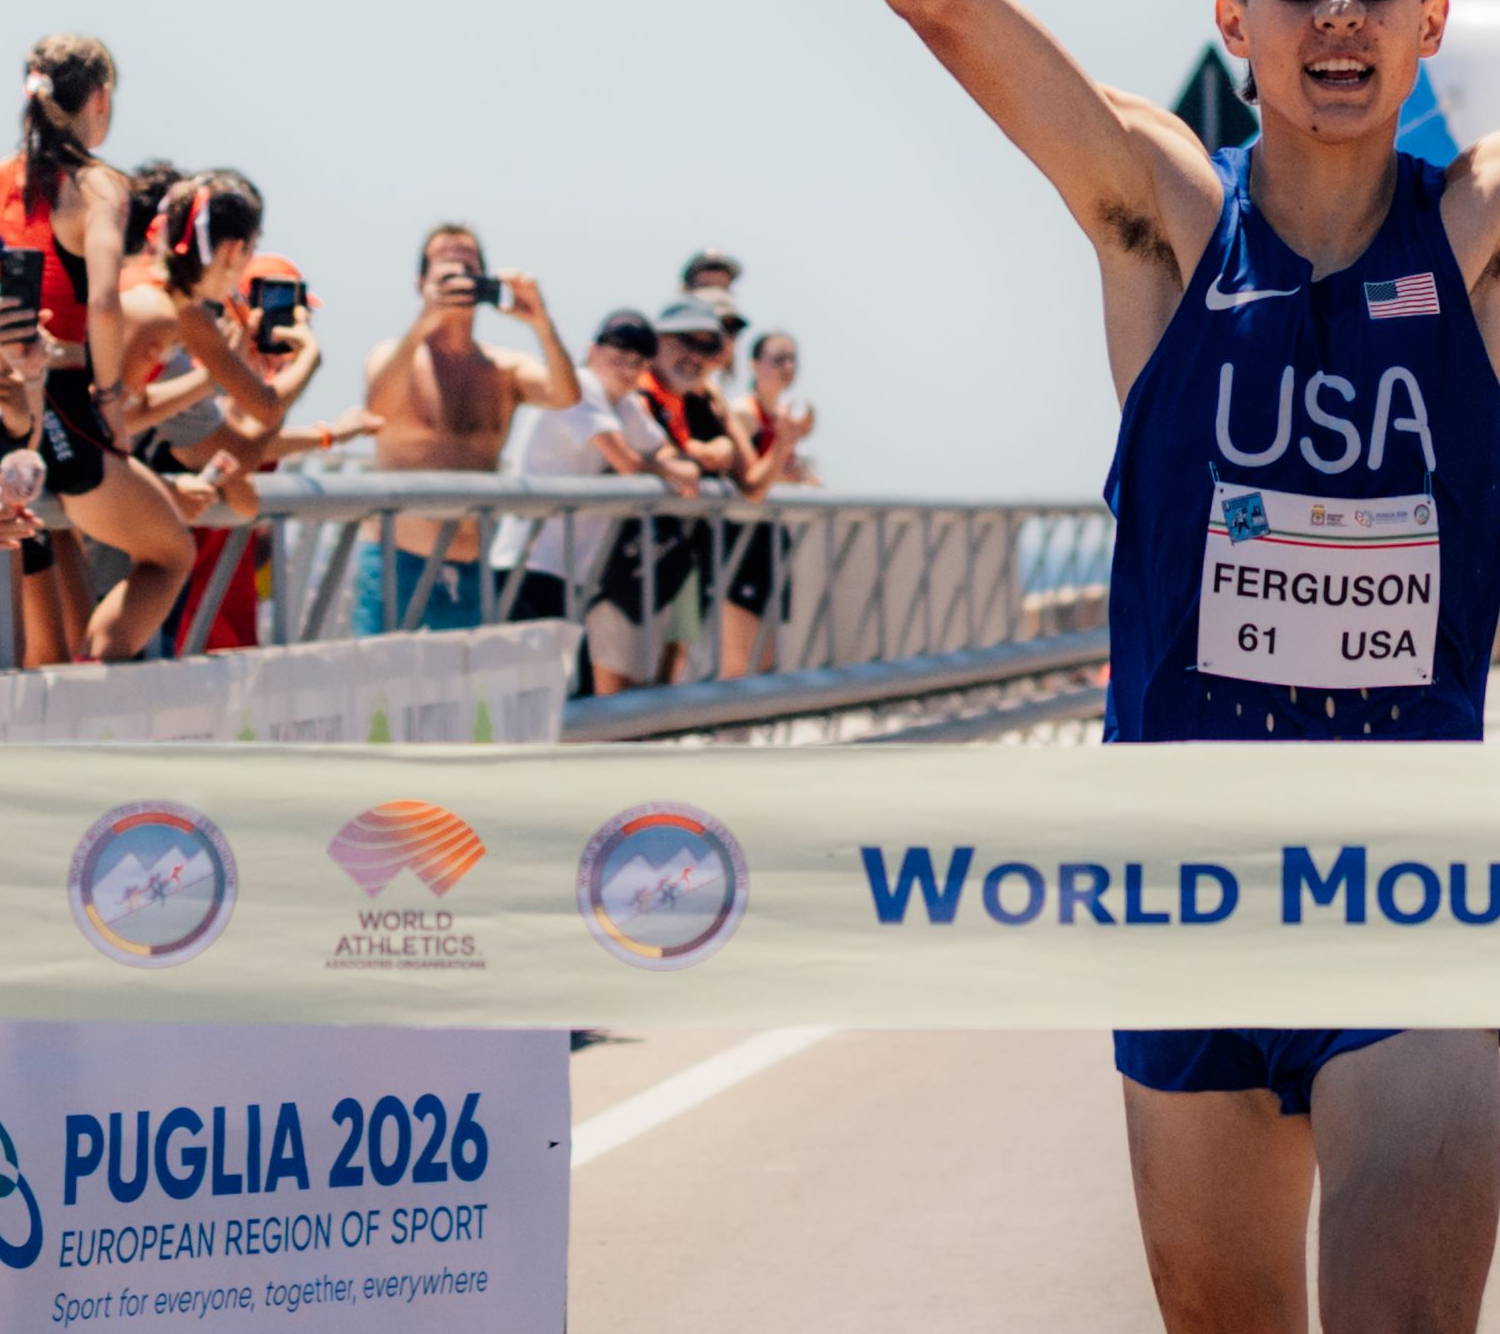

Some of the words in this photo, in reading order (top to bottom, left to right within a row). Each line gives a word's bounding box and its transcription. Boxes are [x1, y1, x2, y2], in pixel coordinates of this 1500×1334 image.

[1215, 362, 1437, 475] USA
[1213, 562, 1431, 607] FERGUSON
[1238, 623, 1277, 655] 61
[1341, 630, 1417, 661] USA
[860, 846, 1239, 925] WORLD
[335, 935, 476, 956] ATHLETICS
[358, 910, 453, 931] WORLD
[63, 1102, 310, 1205] PUGLIA
[329, 1092, 489, 1188] 2026
[59, 1221, 216, 1268] EUROPEAN
[225, 1212, 332, 1257] REGION
[341, 1210, 380, 1247] OF
[391, 1204, 488, 1245] SPORT
[51, 1291, 113, 1328] Sport
[119, 1287, 149, 1318] for
[154, 1283, 255, 1319] everyone,
[265, 1274, 357, 1315] together,
[363, 1266, 488, 1304] everywhere
